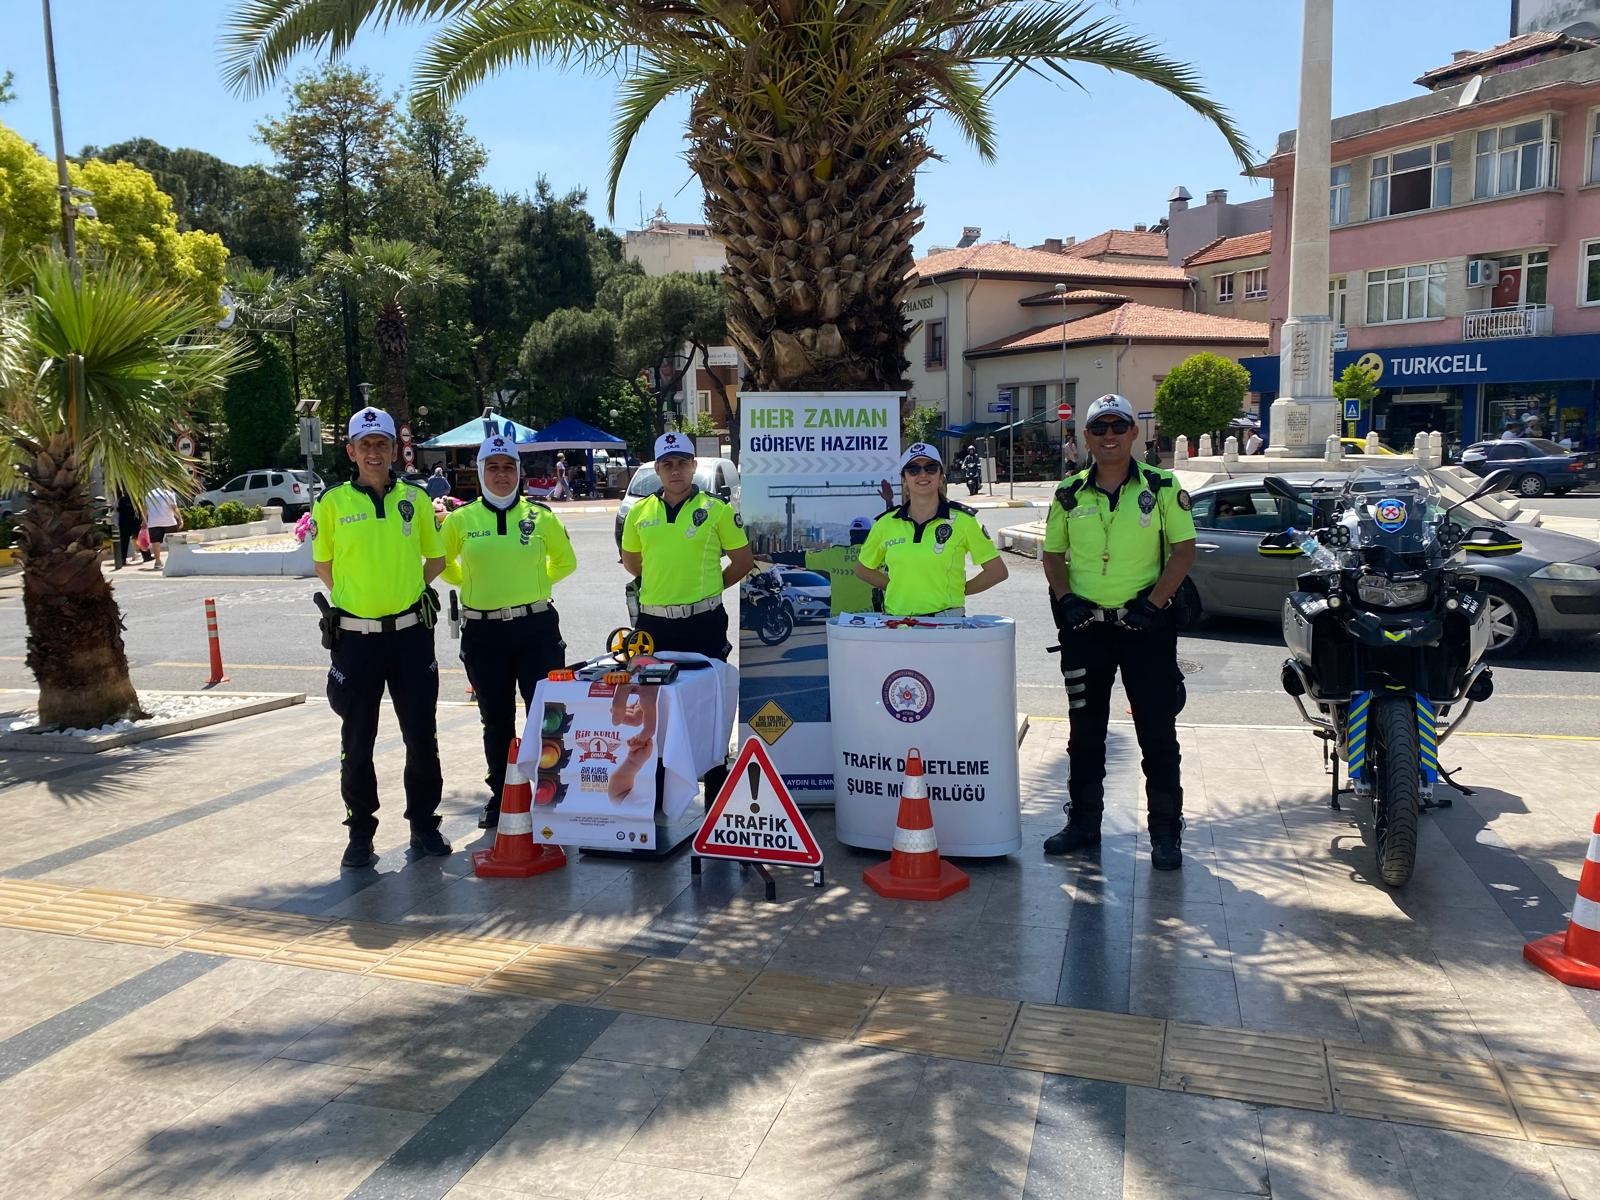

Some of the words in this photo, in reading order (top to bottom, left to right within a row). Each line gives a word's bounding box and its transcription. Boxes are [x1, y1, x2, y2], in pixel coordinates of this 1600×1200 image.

[1390, 353, 1488, 376] TURKCELL
[751, 408, 794, 429] HER
[804, 407, 887, 429] ZAMAN
[750, 434, 815, 452] GÖREVE
[821, 435, 888, 452] HAZIRIZ
[594, 740, 601, 752] 1
[842, 751, 892, 772] TRAFİK
[896, 758, 989, 775] DETLEME
[847, 777, 883, 796] ŞUBE
[887, 782, 985, 802] MRLÜĞÜ
[722, 814, 788, 833] TRAFİK
[714, 829, 798, 850] KONTROL
